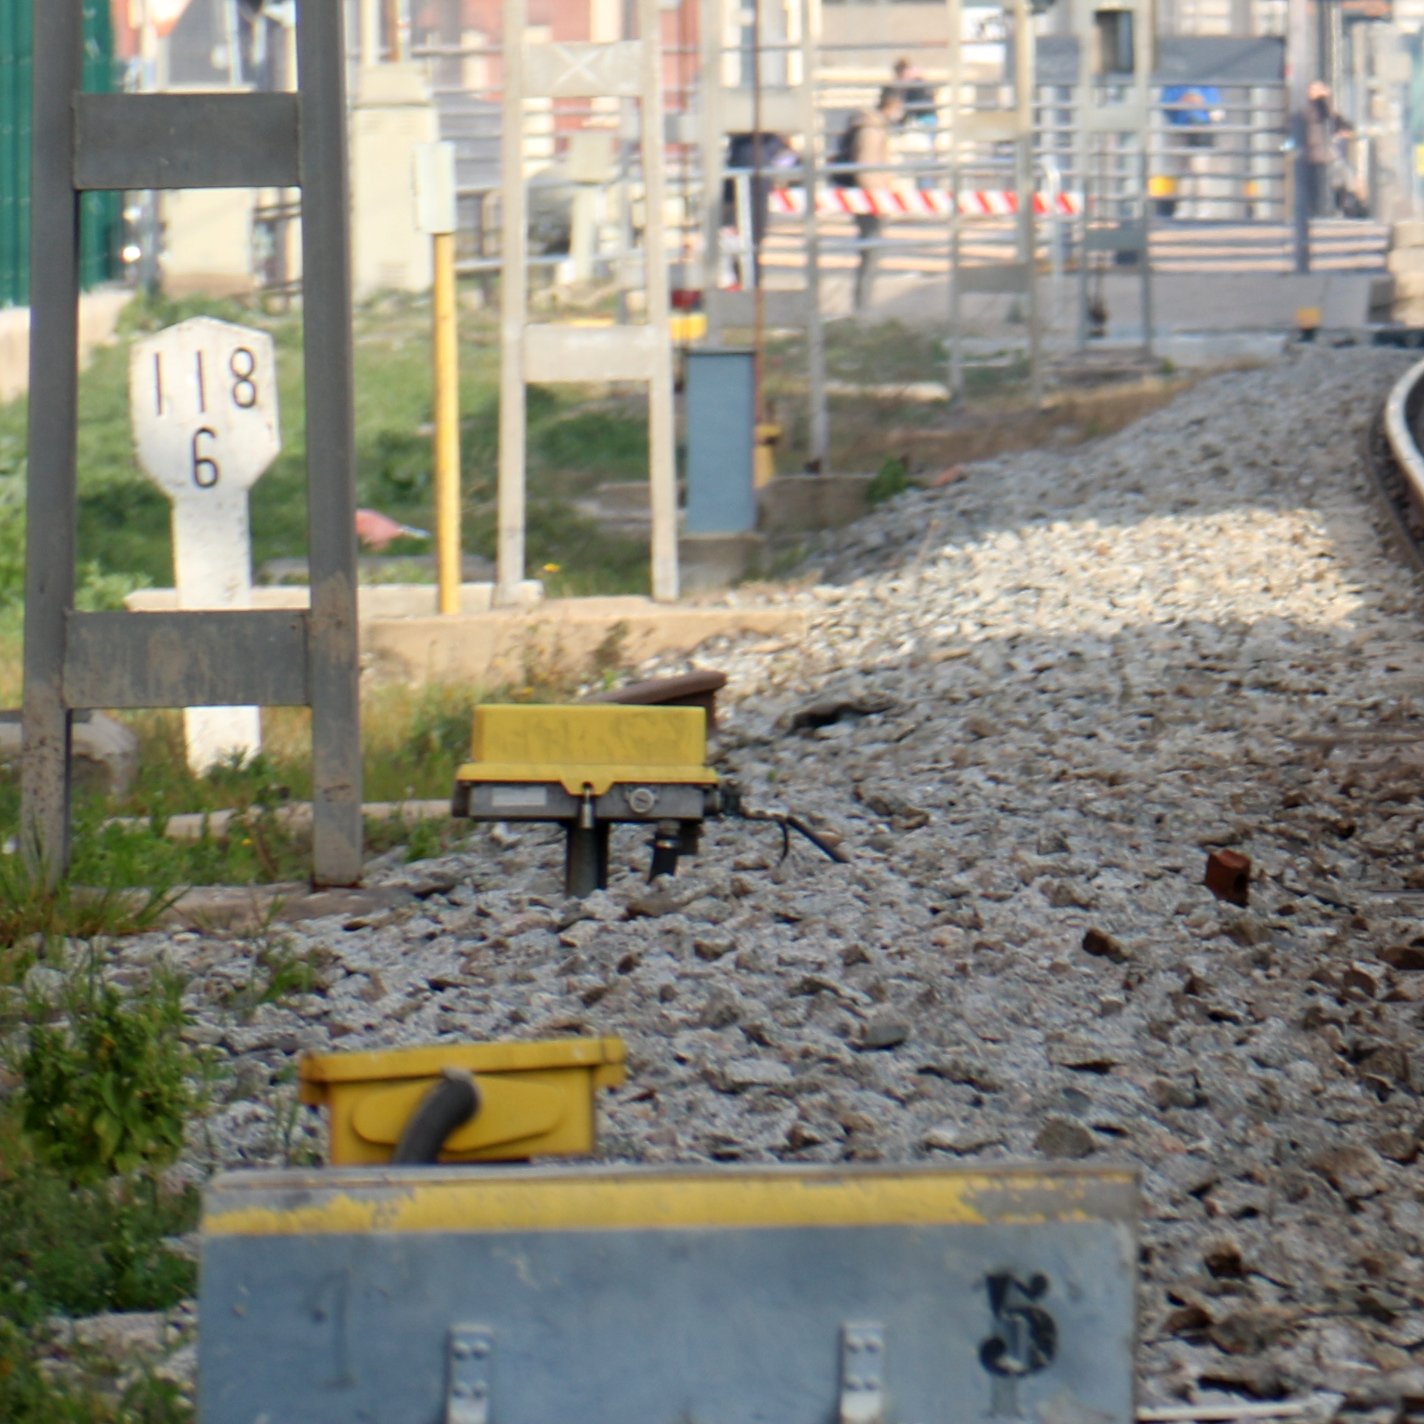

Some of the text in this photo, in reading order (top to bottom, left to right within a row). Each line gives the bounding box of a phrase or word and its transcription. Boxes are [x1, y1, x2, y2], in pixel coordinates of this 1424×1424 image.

[155, 346, 257, 416] 118
[192, 427, 219, 489] 6
[979, 1268, 1058, 1378] 5
